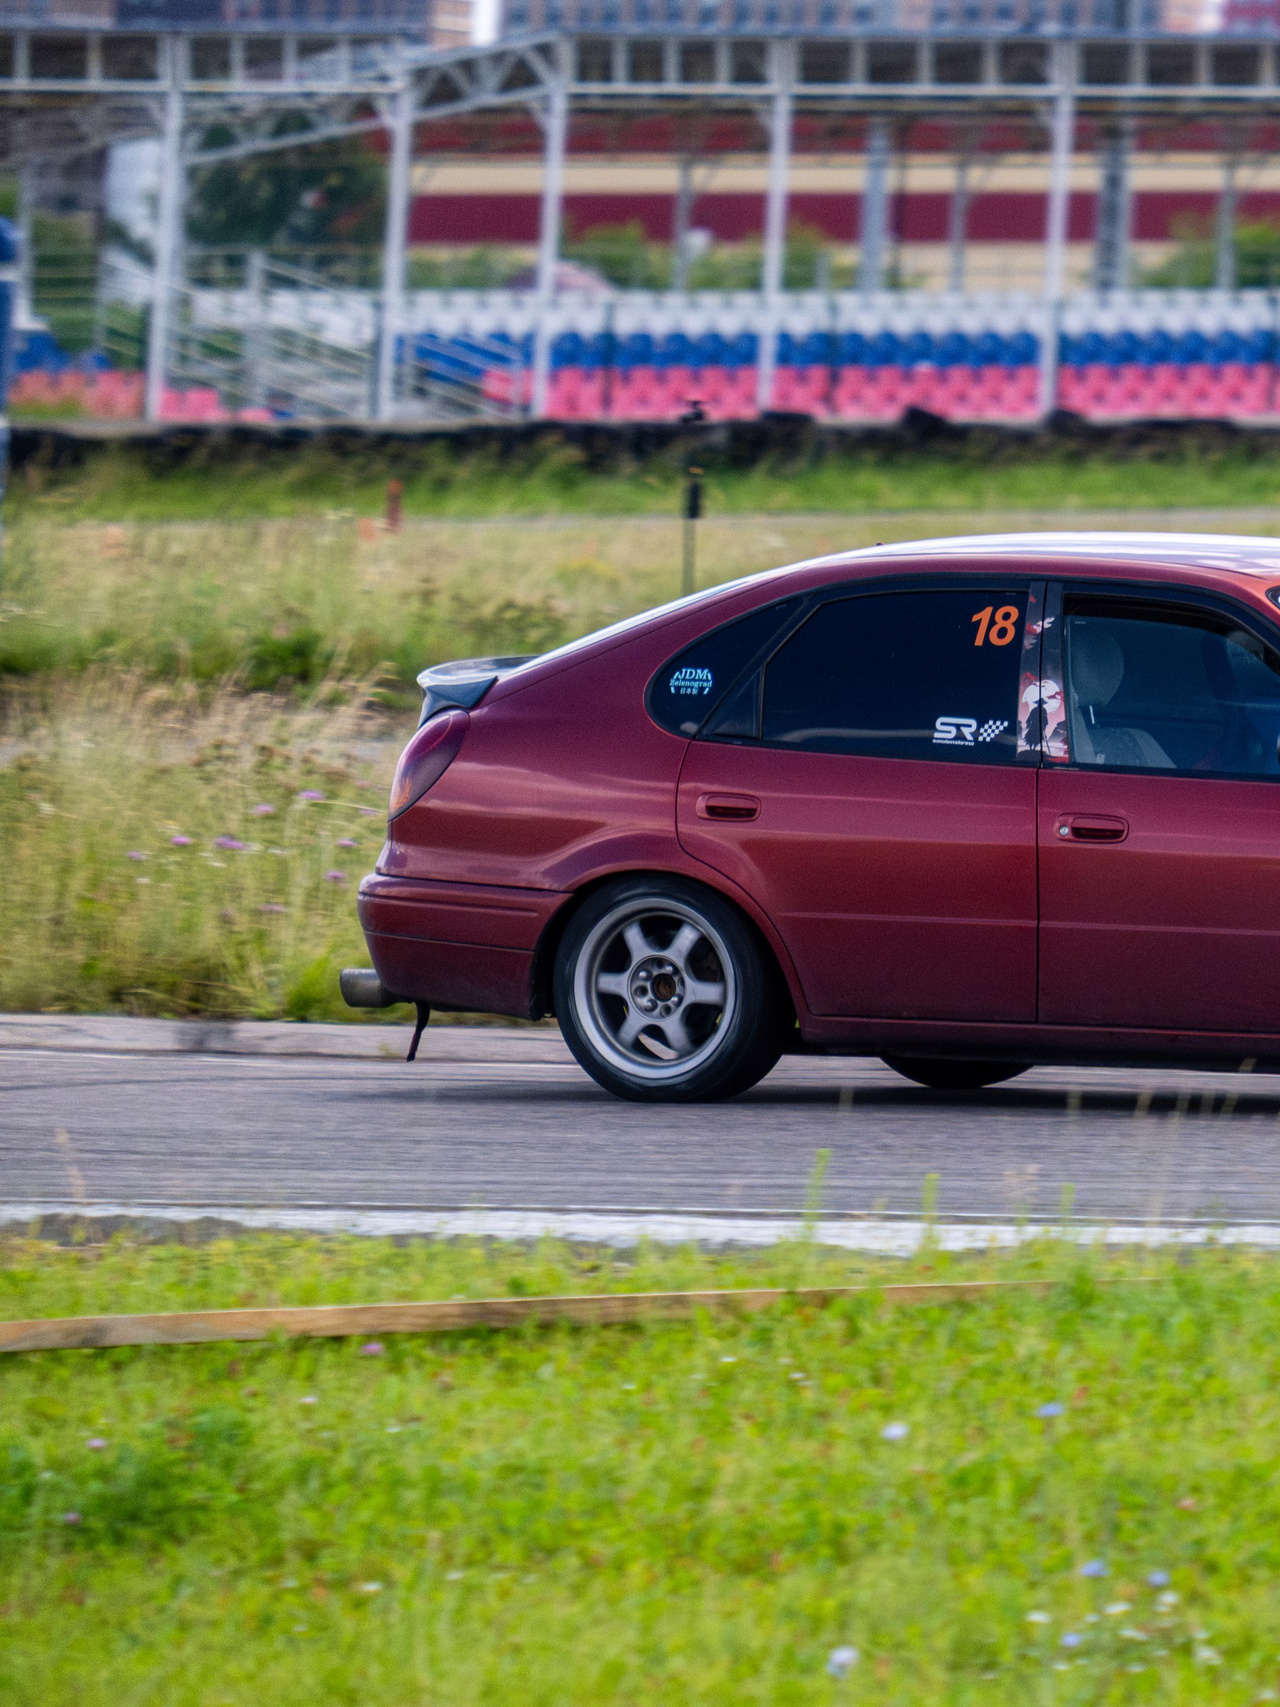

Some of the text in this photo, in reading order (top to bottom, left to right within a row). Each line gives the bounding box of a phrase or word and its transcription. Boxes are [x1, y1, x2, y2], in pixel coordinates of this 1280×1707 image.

[971, 605, 1019, 647] 18
[678, 668, 709, 680] JDM
[669, 679, 713, 688] Zelenograd
[933, 716, 977, 741] SR
